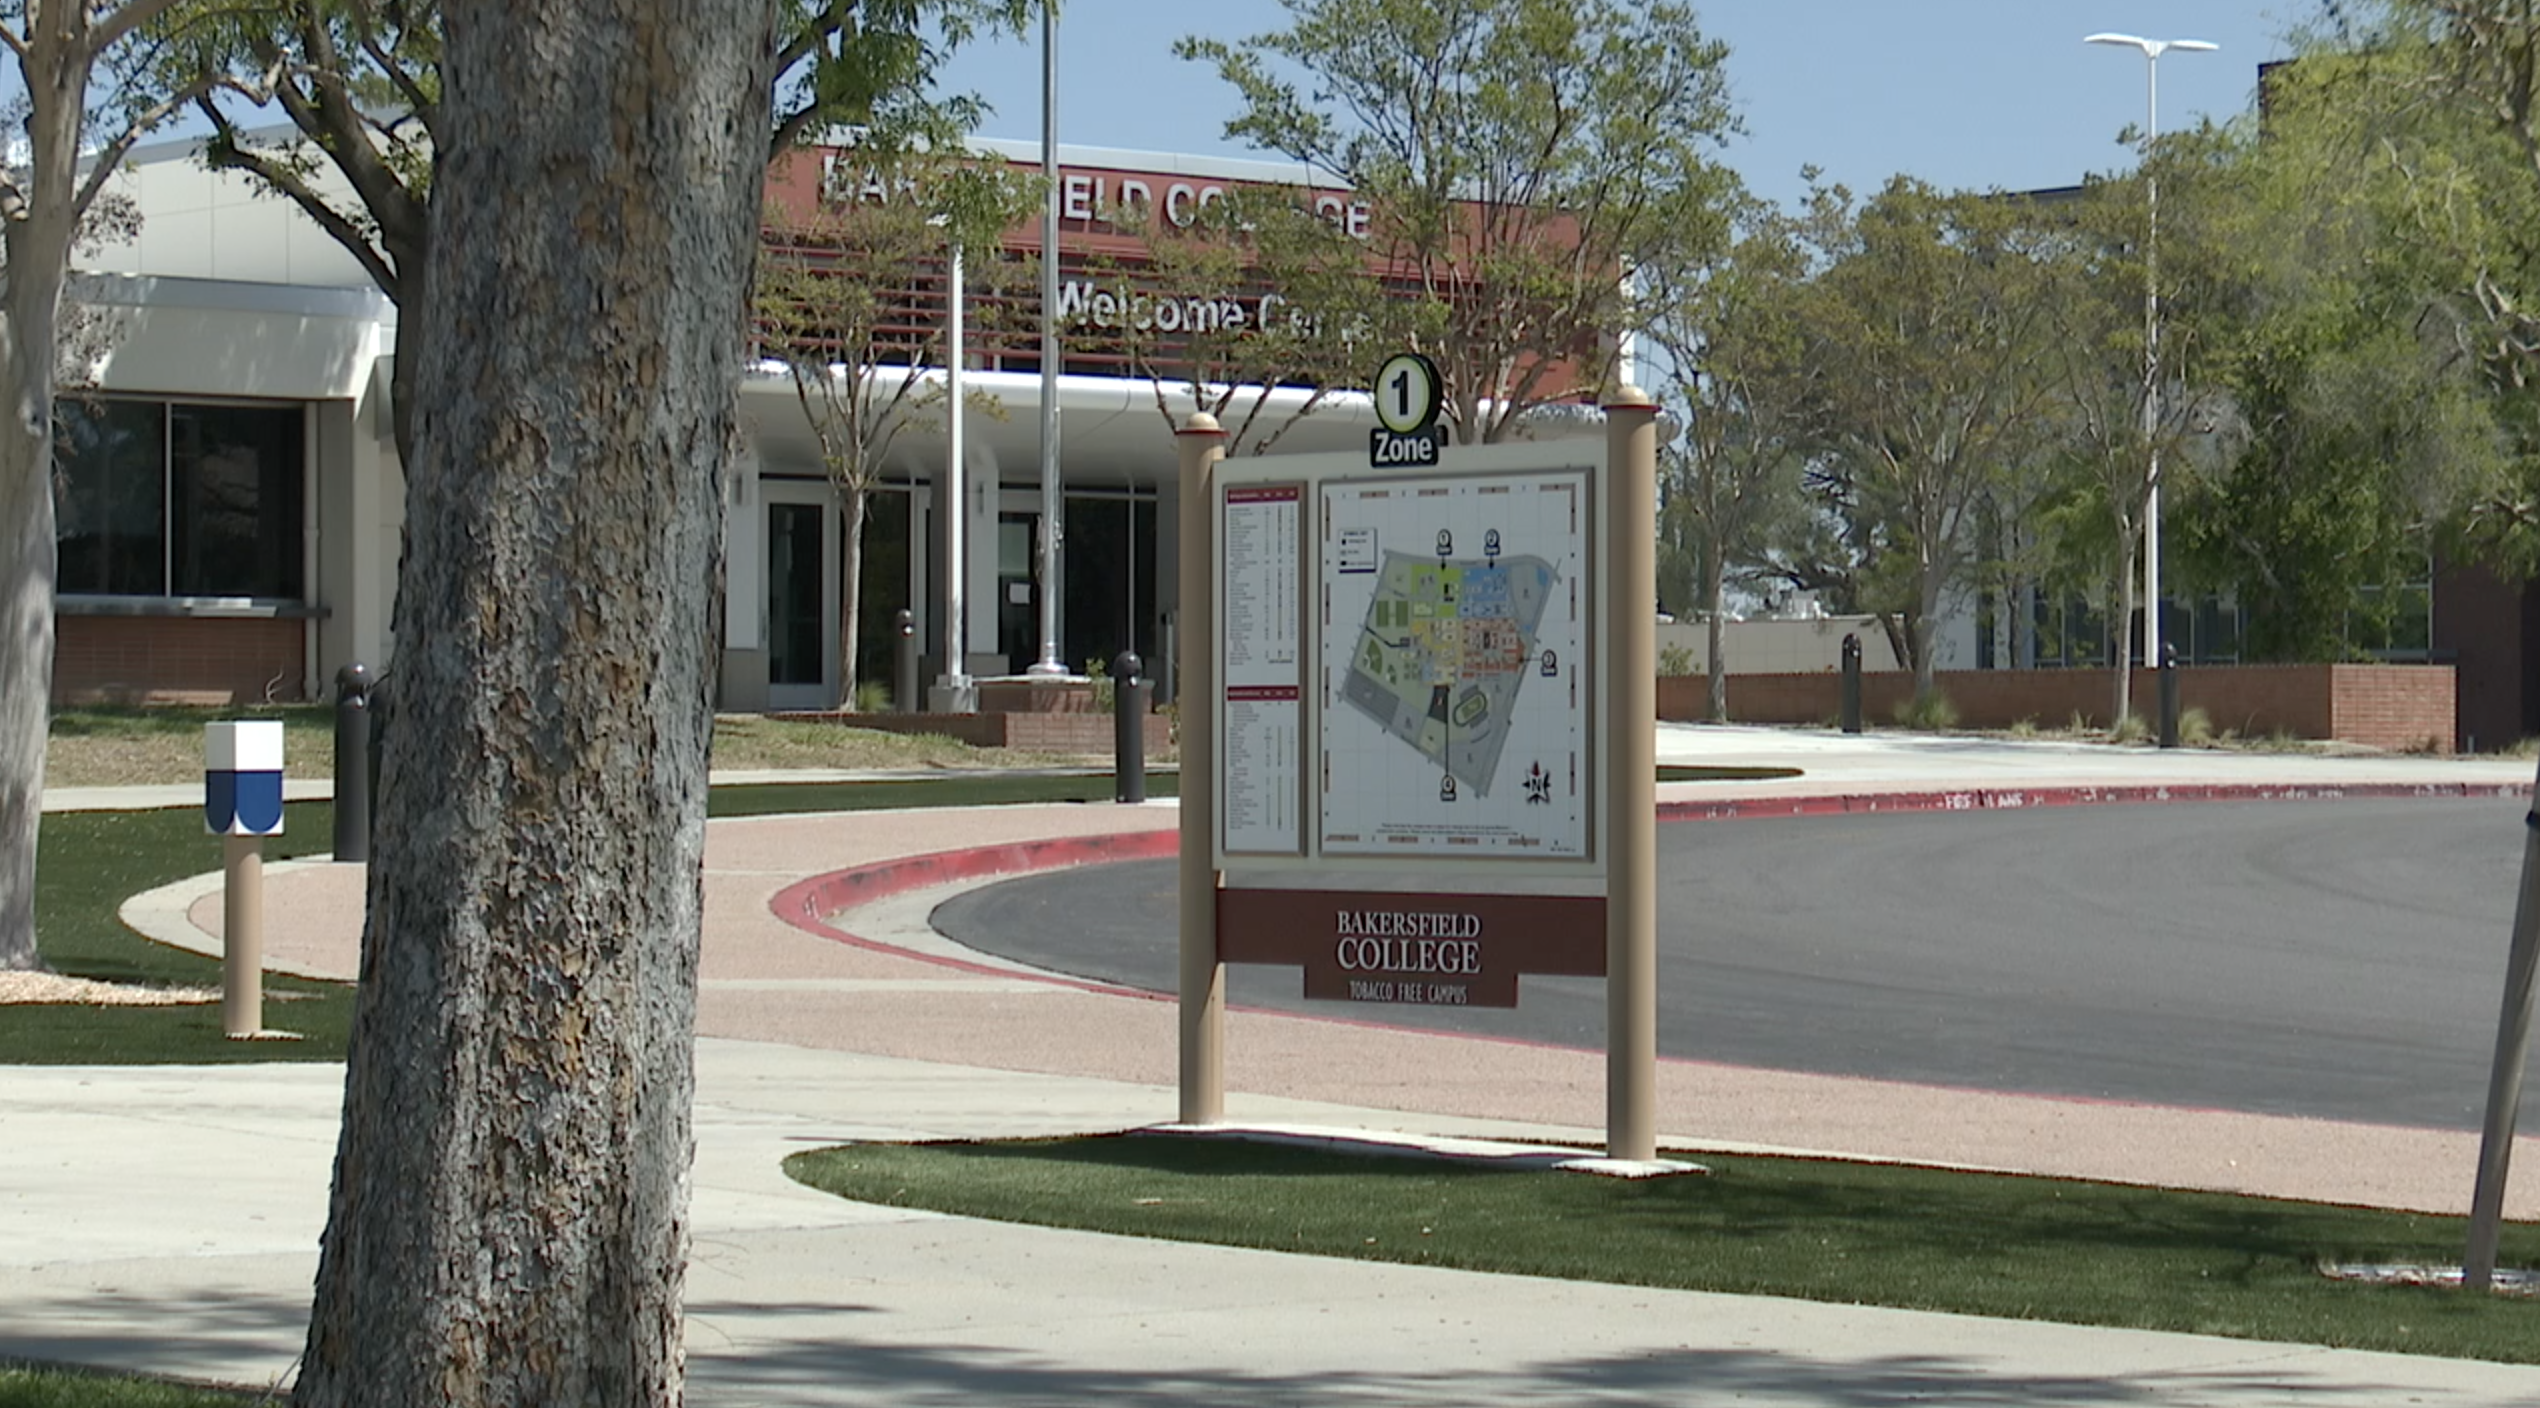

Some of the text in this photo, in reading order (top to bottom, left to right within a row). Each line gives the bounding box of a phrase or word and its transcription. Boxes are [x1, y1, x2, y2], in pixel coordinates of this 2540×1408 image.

[823, 155, 1372, 240] BAKELD COGE
[1057, 281, 1244, 332] Welcome
[1391, 370, 1408, 416] 1
[1375, 432, 1433, 462] Zone
[1532, 778, 1542, 792] N
[1337, 911, 1481, 937] BAKERSFIELD
[1337, 937, 1481, 974] COLLEGE
[1350, 980, 1467, 1004] TOBACCO FREE CAMPUS
